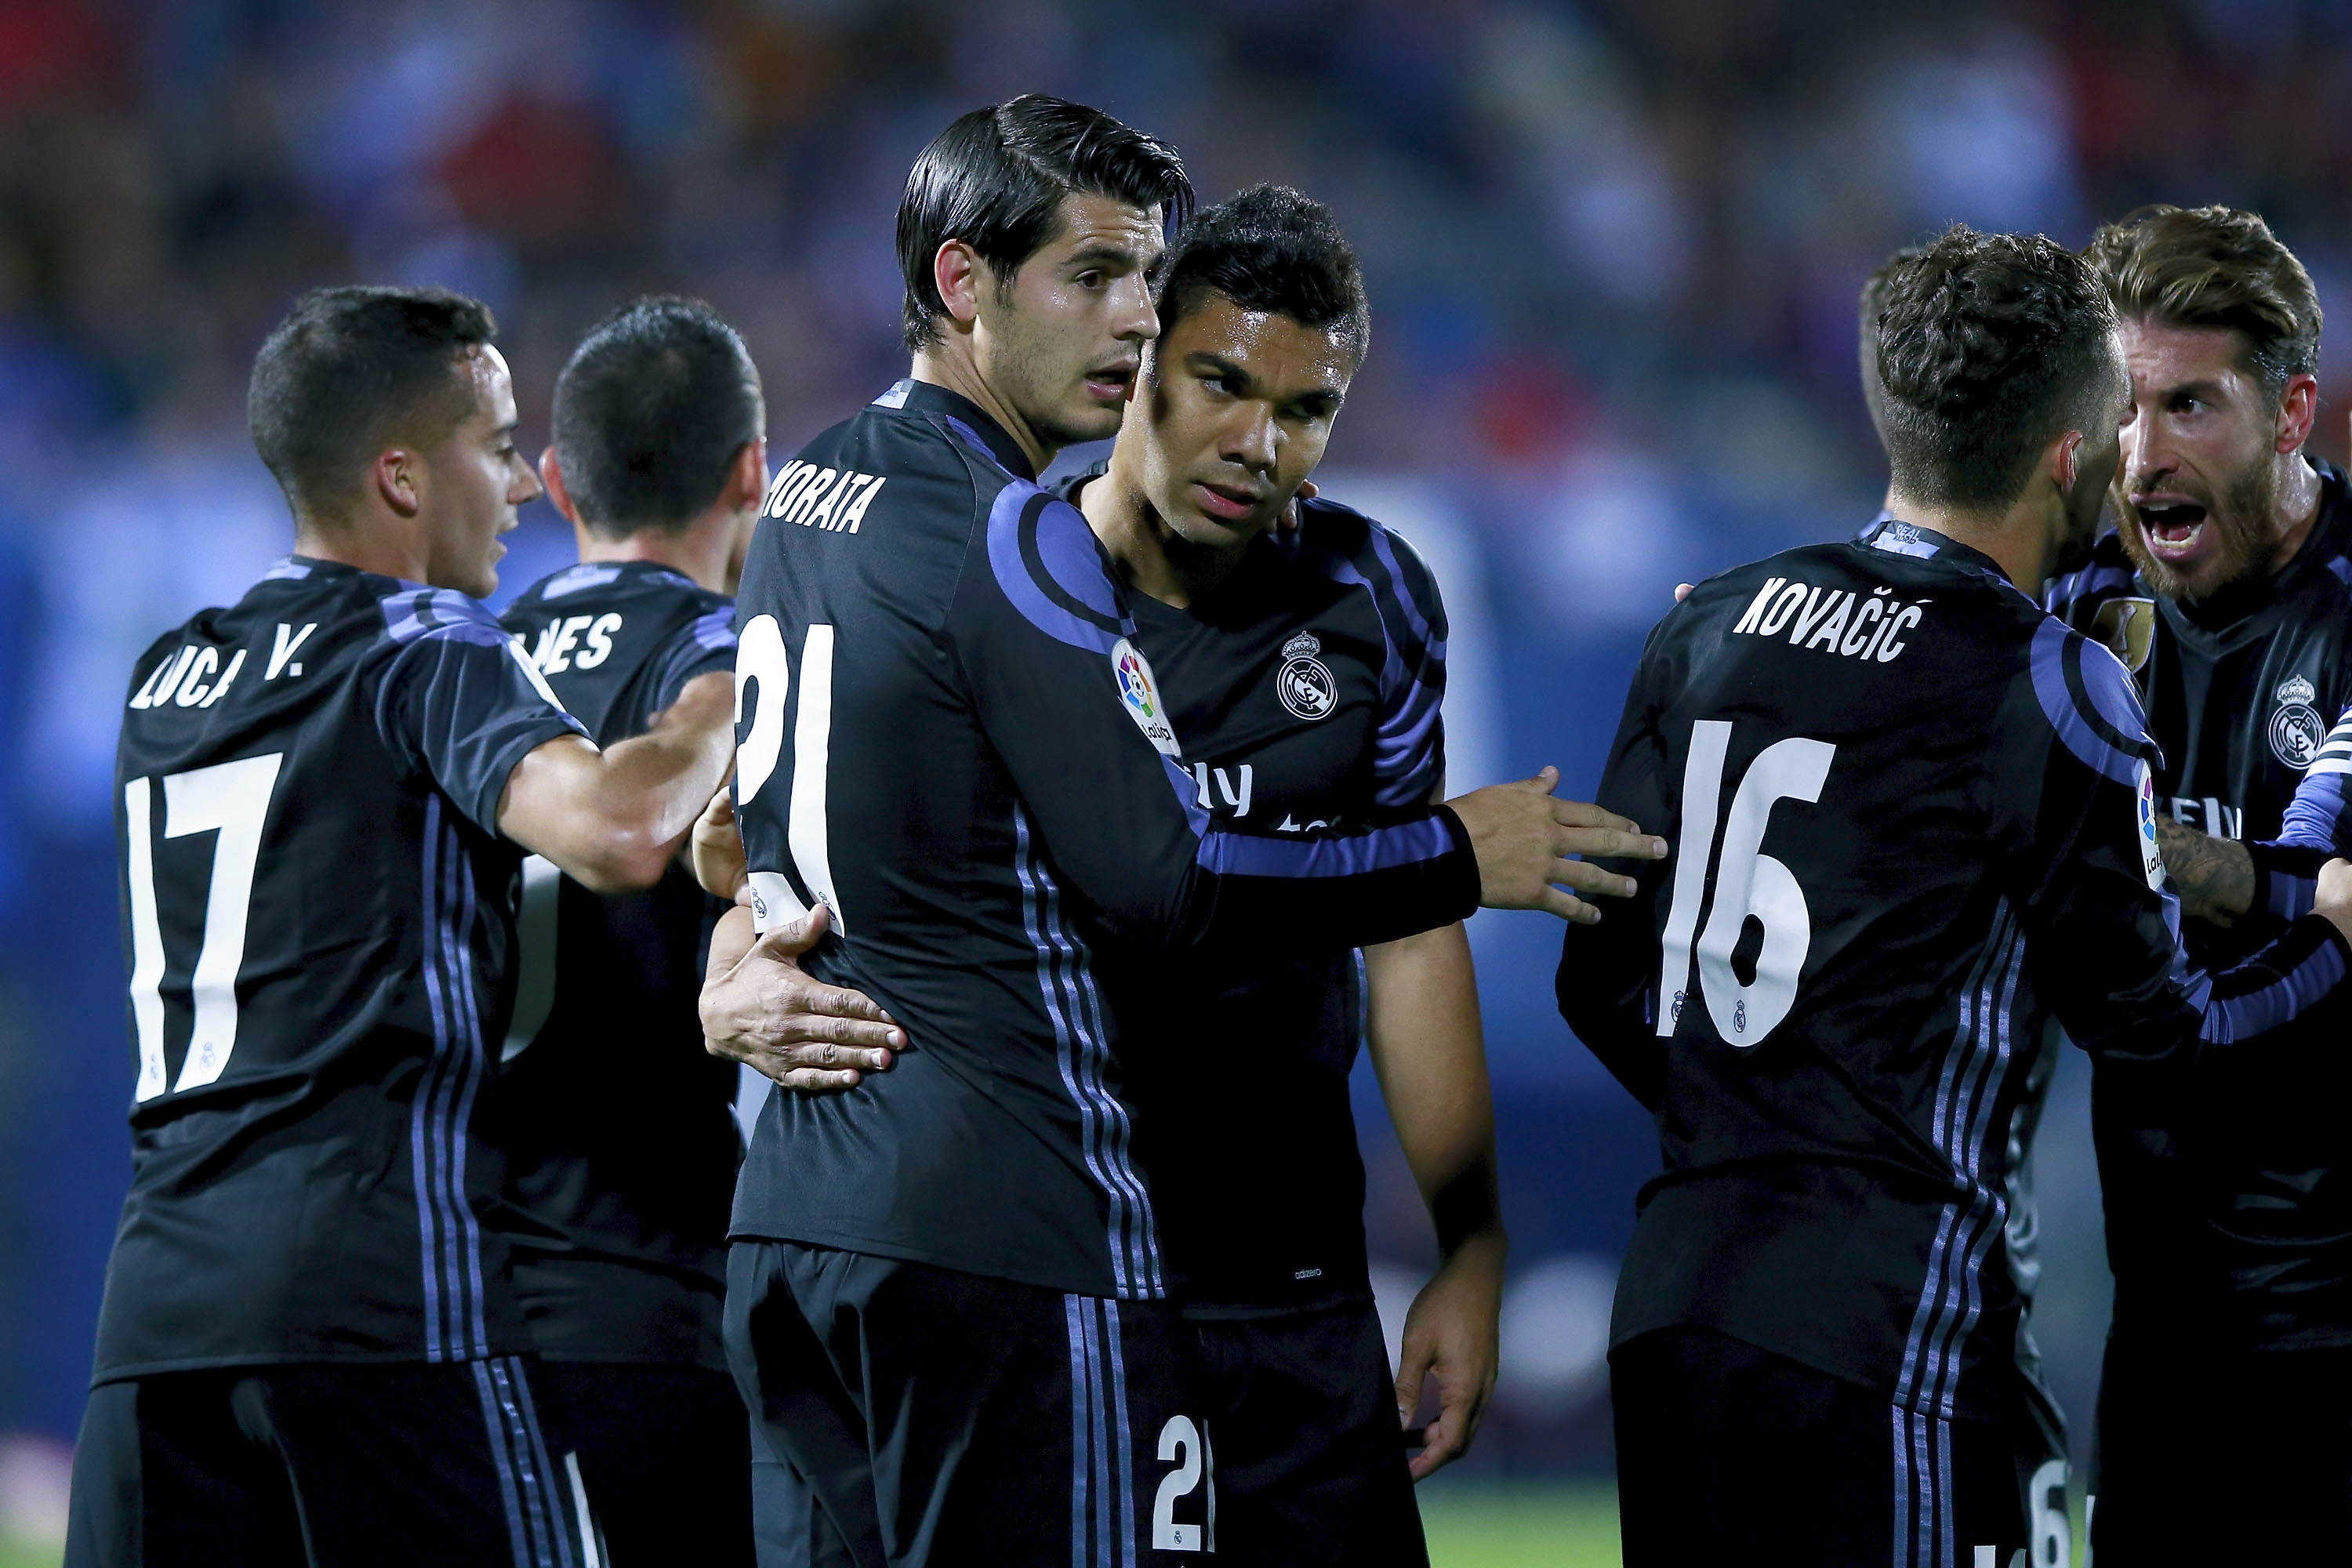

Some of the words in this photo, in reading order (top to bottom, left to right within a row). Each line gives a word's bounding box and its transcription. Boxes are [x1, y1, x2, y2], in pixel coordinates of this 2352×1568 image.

[762, 459, 887, 535] MORATA
[264, 623, 318, 681] V.
[734, 613, 845, 939] 21
[1184, 762, 1253, 818] ly
[125, 753, 283, 1104] 17
[1656, 720, 1836, 1047] 16
